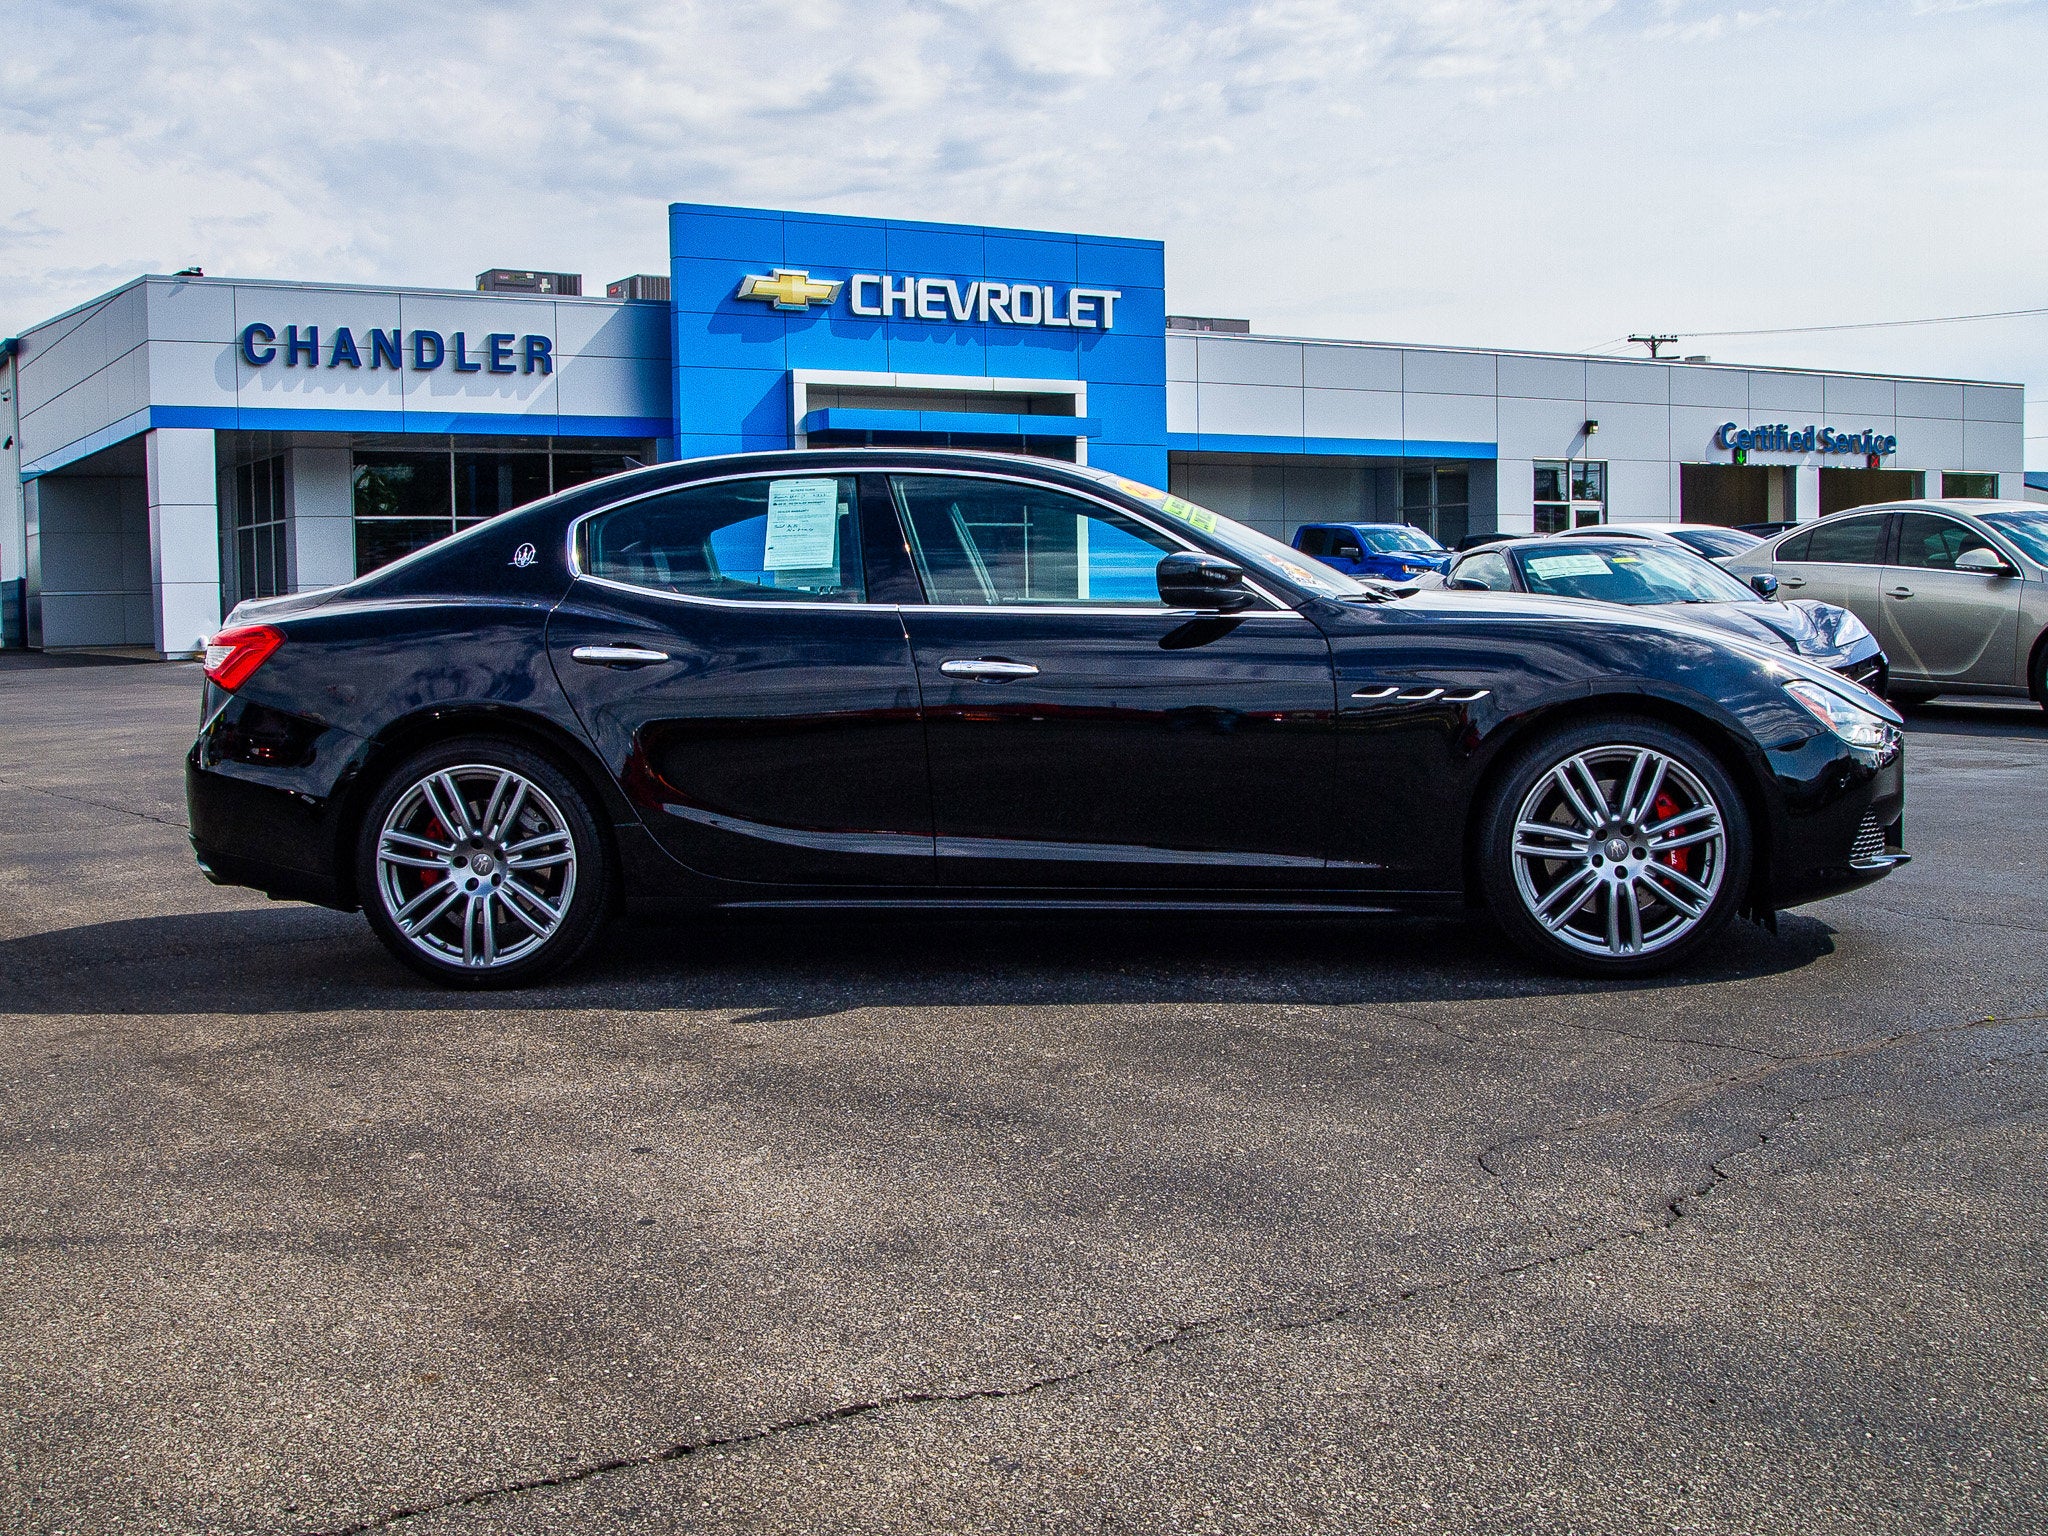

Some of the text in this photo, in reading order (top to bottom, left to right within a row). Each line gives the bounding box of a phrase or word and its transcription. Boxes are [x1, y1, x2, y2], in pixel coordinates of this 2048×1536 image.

[851, 274, 1122, 329] CHEVROLET
[242, 322, 554, 375] CHANDLER
[1720, 422, 1897, 455] Certified Service
